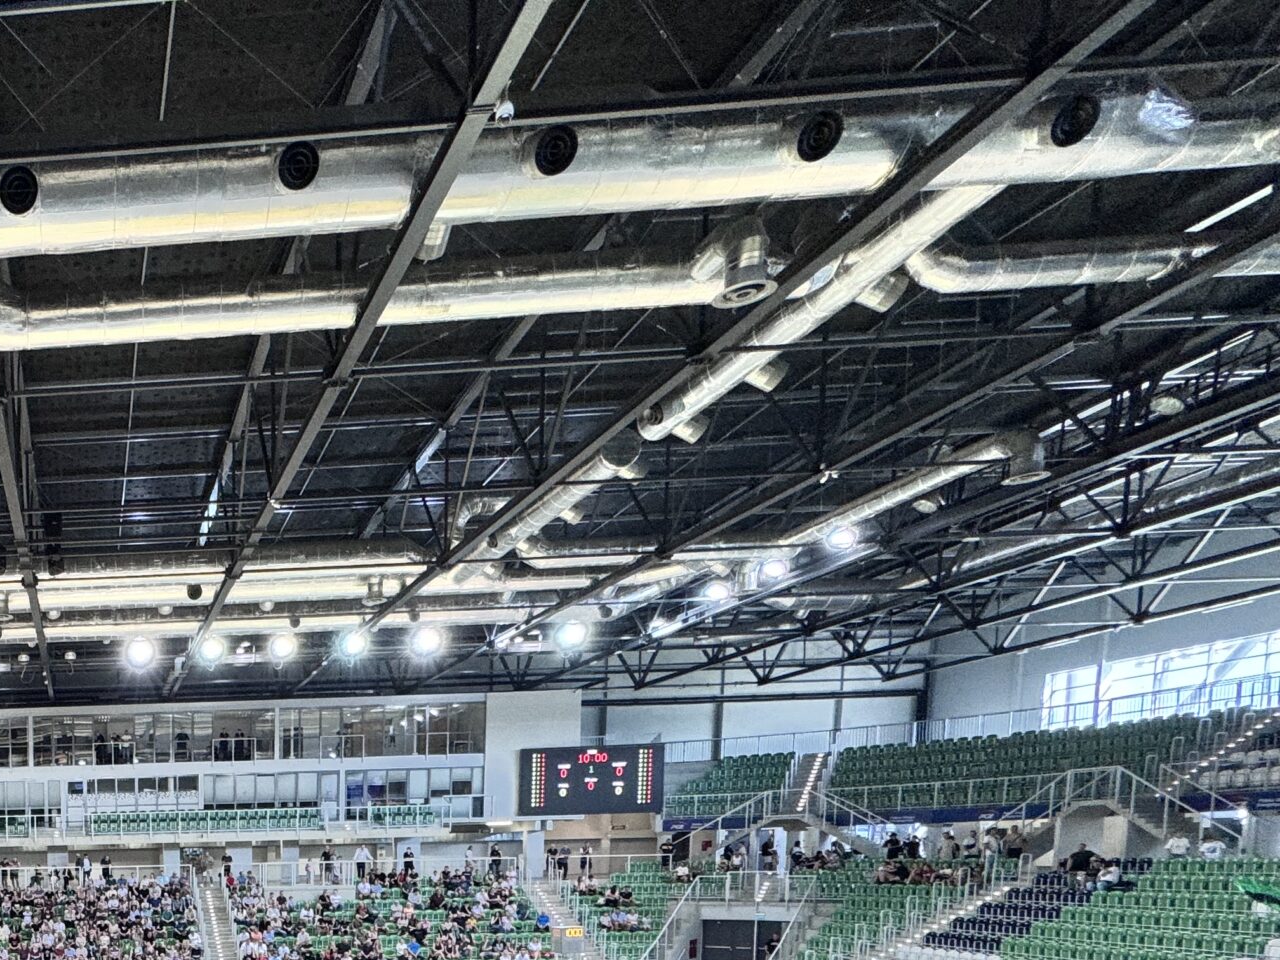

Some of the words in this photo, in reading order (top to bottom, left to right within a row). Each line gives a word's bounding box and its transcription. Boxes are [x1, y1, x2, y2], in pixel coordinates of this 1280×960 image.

[578, 752, 608, 764] 10:00
[560, 769, 568, 778] 0
[616, 767, 624, 776] 0
